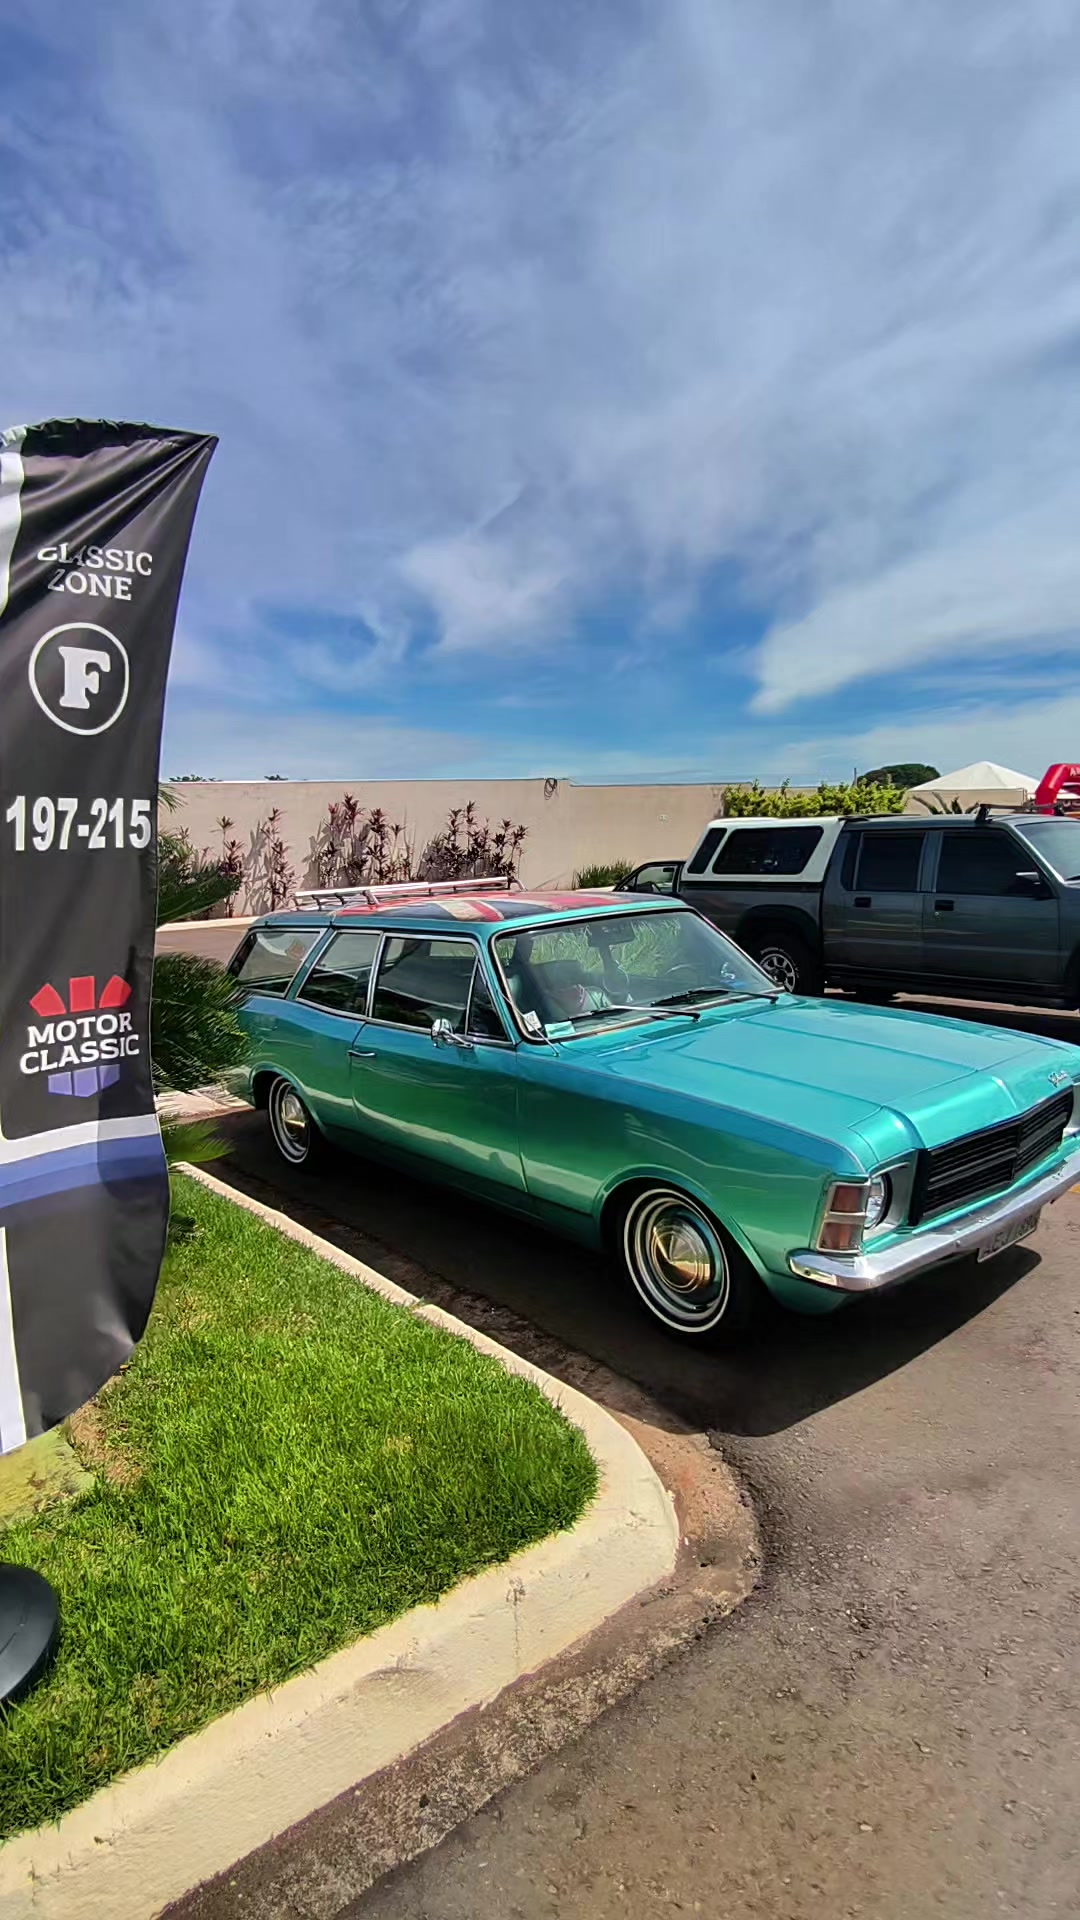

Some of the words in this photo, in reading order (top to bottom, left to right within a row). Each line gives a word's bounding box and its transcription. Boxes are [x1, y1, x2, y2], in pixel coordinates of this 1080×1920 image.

[37, 542, 152, 576] CLASSIC
[48, 568, 132, 600] ZONE
[58, 646, 111, 710] F
[6, 795, 151, 851] 197-215
[27, 1012, 133, 1048] MOTOR
[20, 1034, 139, 1074] CLASSIC
